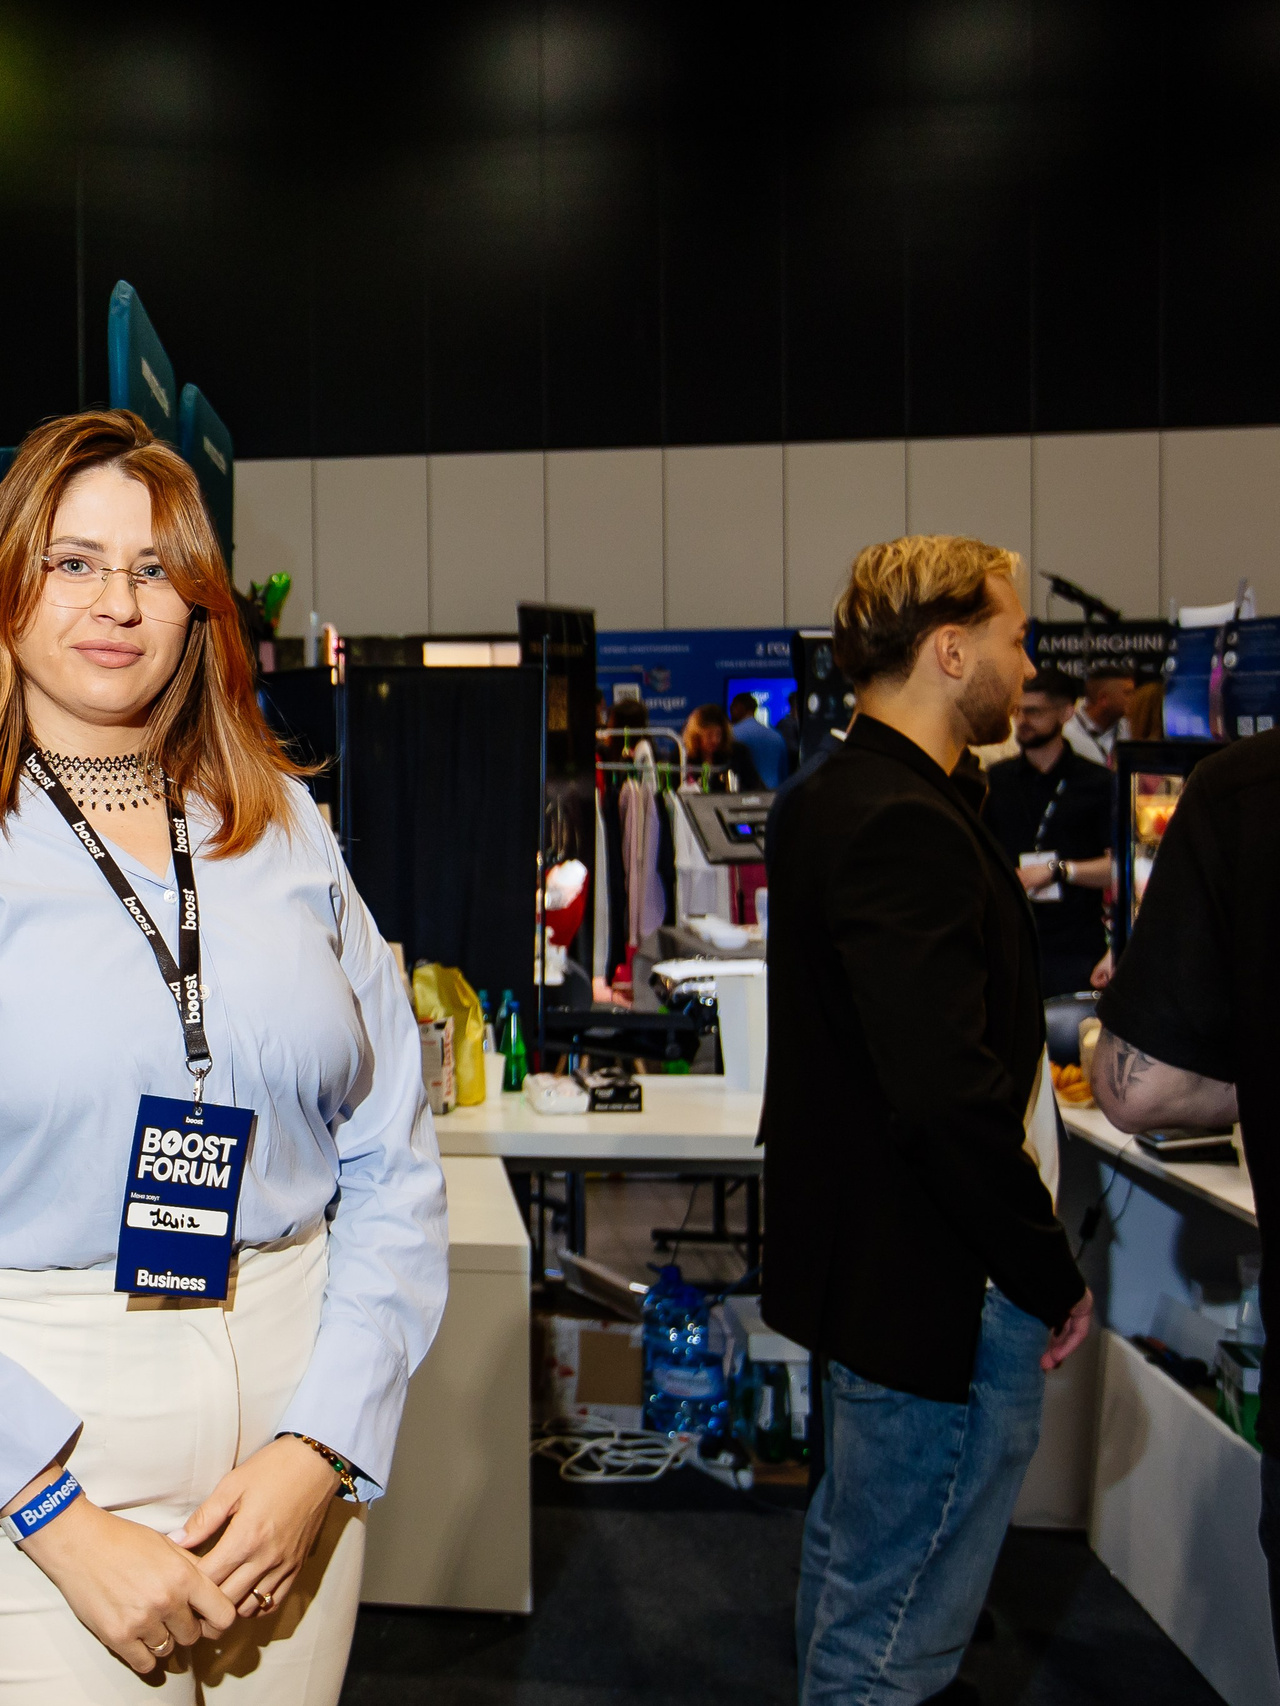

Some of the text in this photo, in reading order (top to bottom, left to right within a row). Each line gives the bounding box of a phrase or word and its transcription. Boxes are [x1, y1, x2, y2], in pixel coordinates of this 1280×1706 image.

[25, 752, 57, 791] boost
[72, 820, 105, 860] boost
[173, 818, 188, 854] boost
[122, 896, 156, 937] boost
[181, 888, 197, 931] boost
[184, 973, 201, 1024] boost
[186, 1116, 204, 1125] boost
[141, 1127, 237, 1163] BOOST
[137, 1155, 231, 1189] FORUM
[136, 1268, 207, 1293] Business
[20, 1476, 79, 1527] Business
